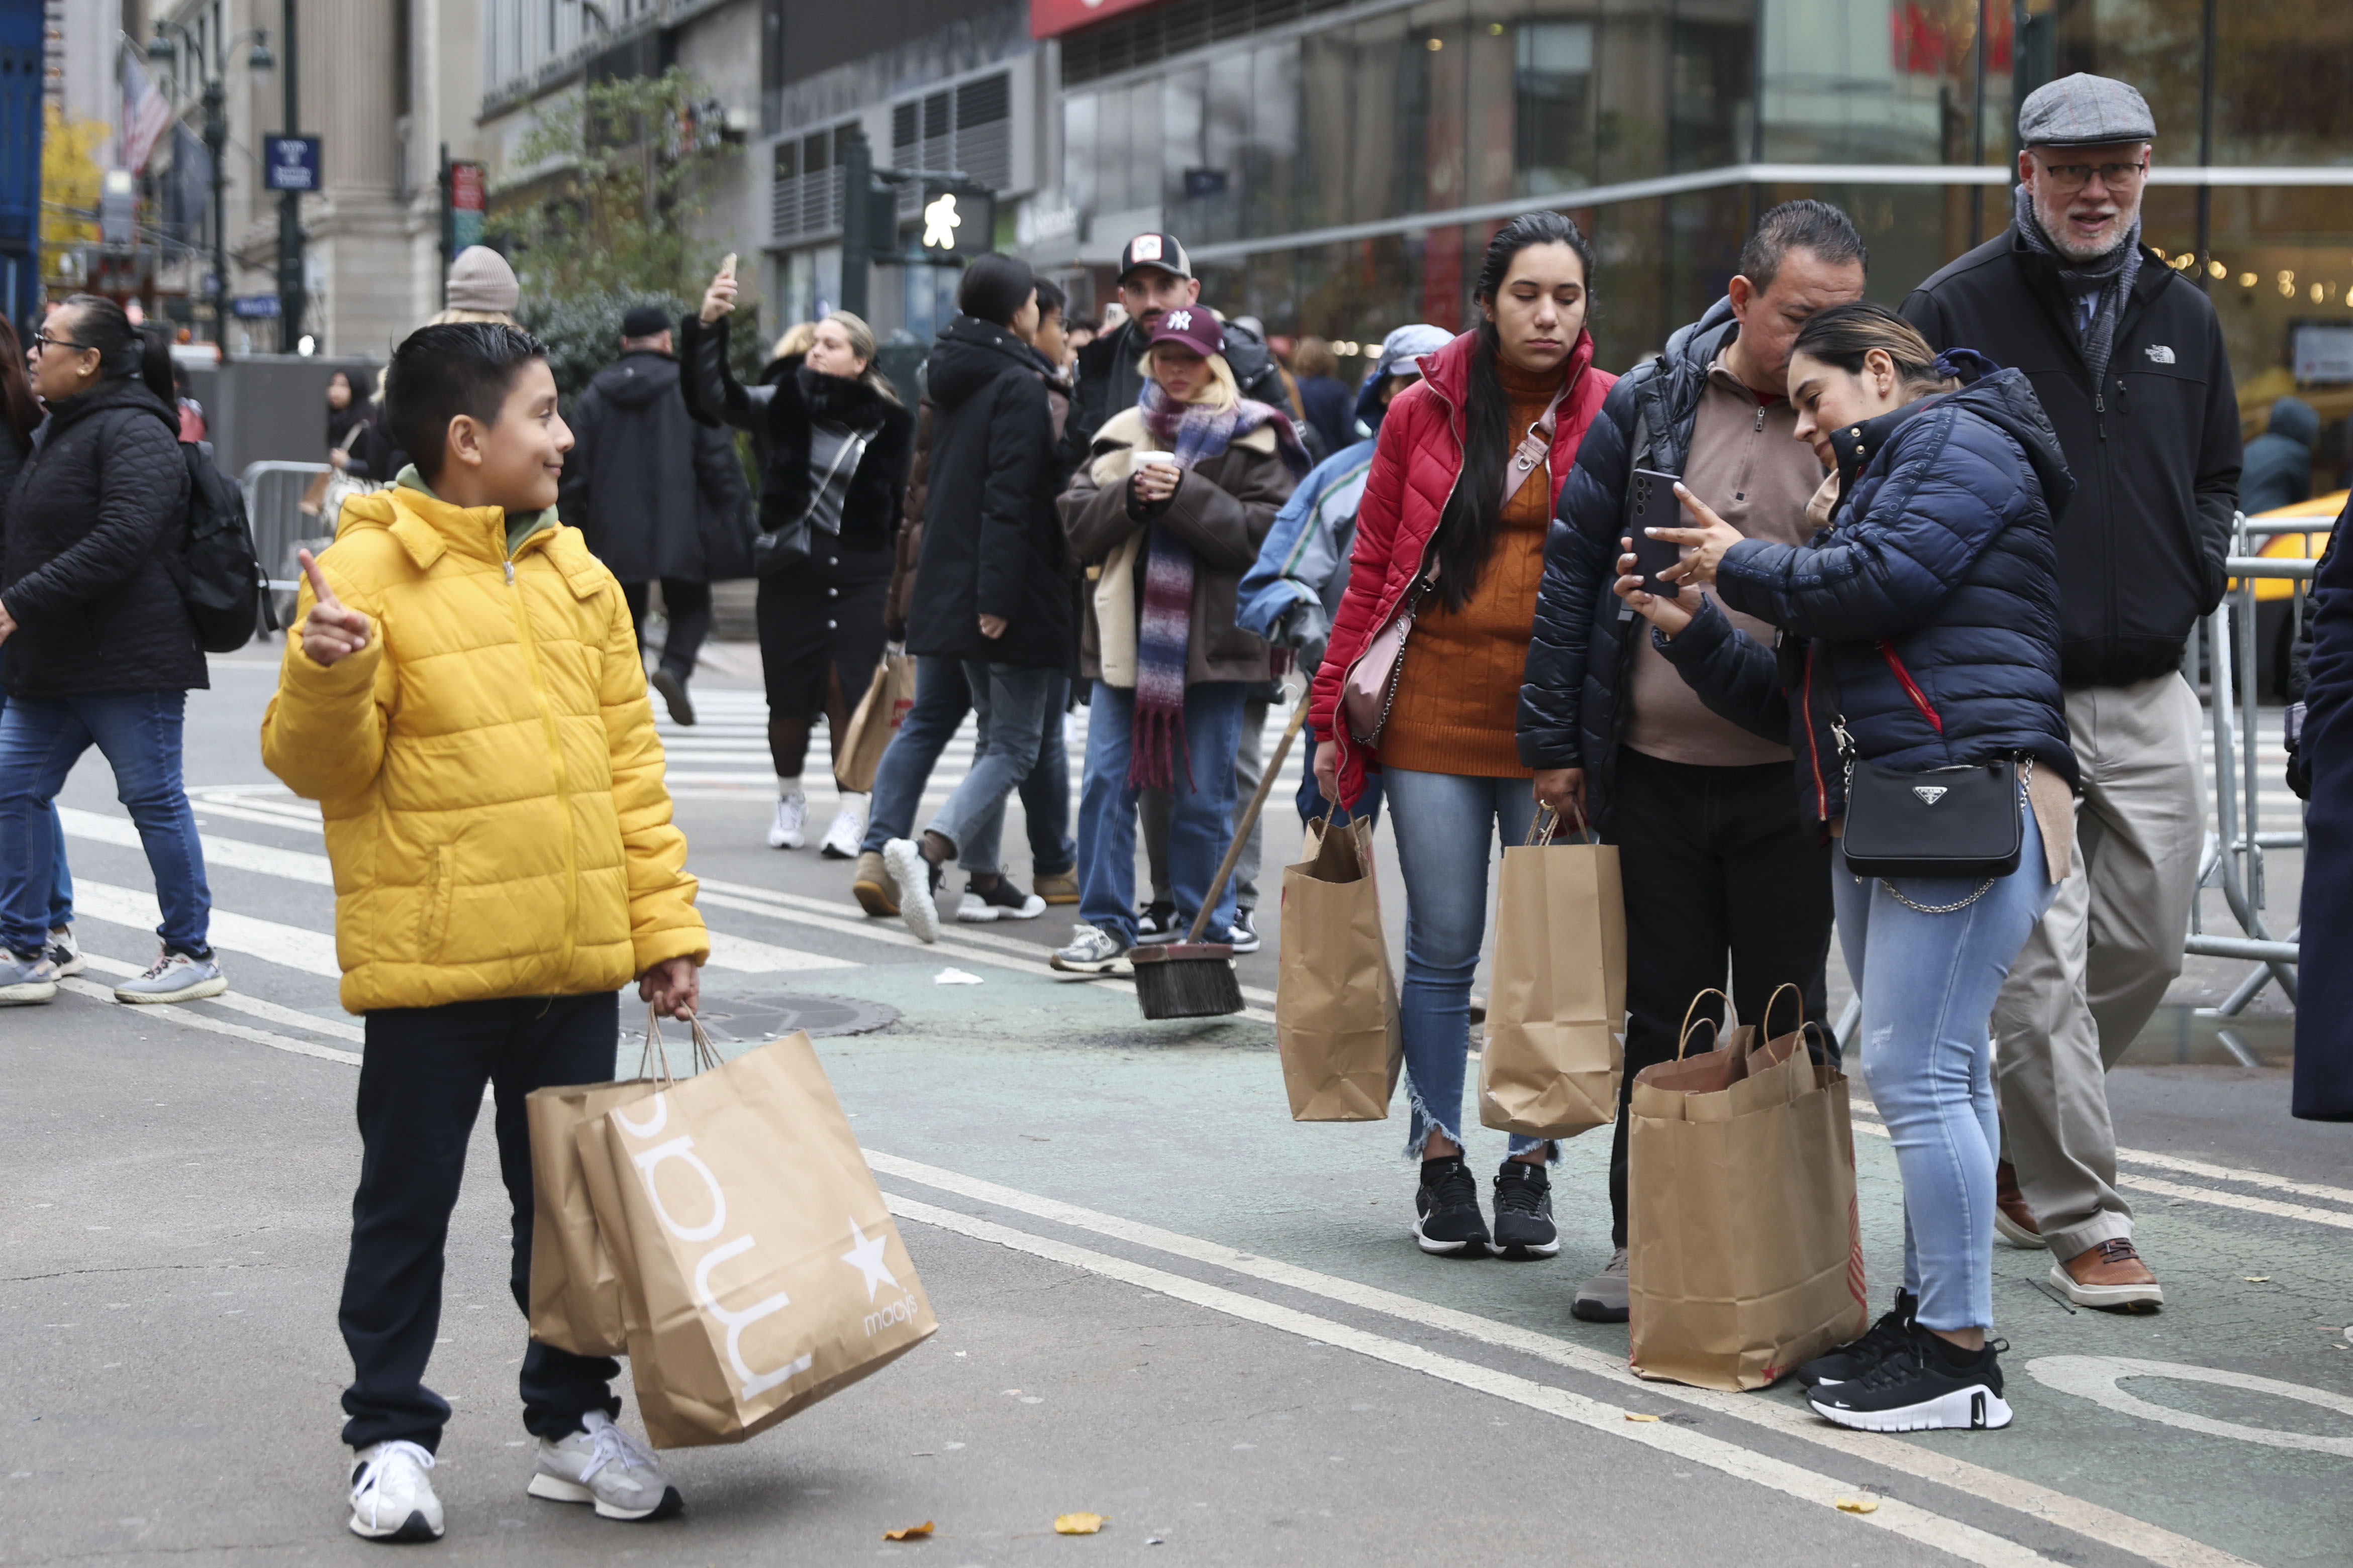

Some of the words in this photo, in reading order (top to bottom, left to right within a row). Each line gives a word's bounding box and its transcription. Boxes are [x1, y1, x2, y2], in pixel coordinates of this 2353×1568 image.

[1166, 310, 1193, 331] NY
[1905, 433, 1944, 484] HILFIGER
[864, 1286, 918, 1337] macy's
